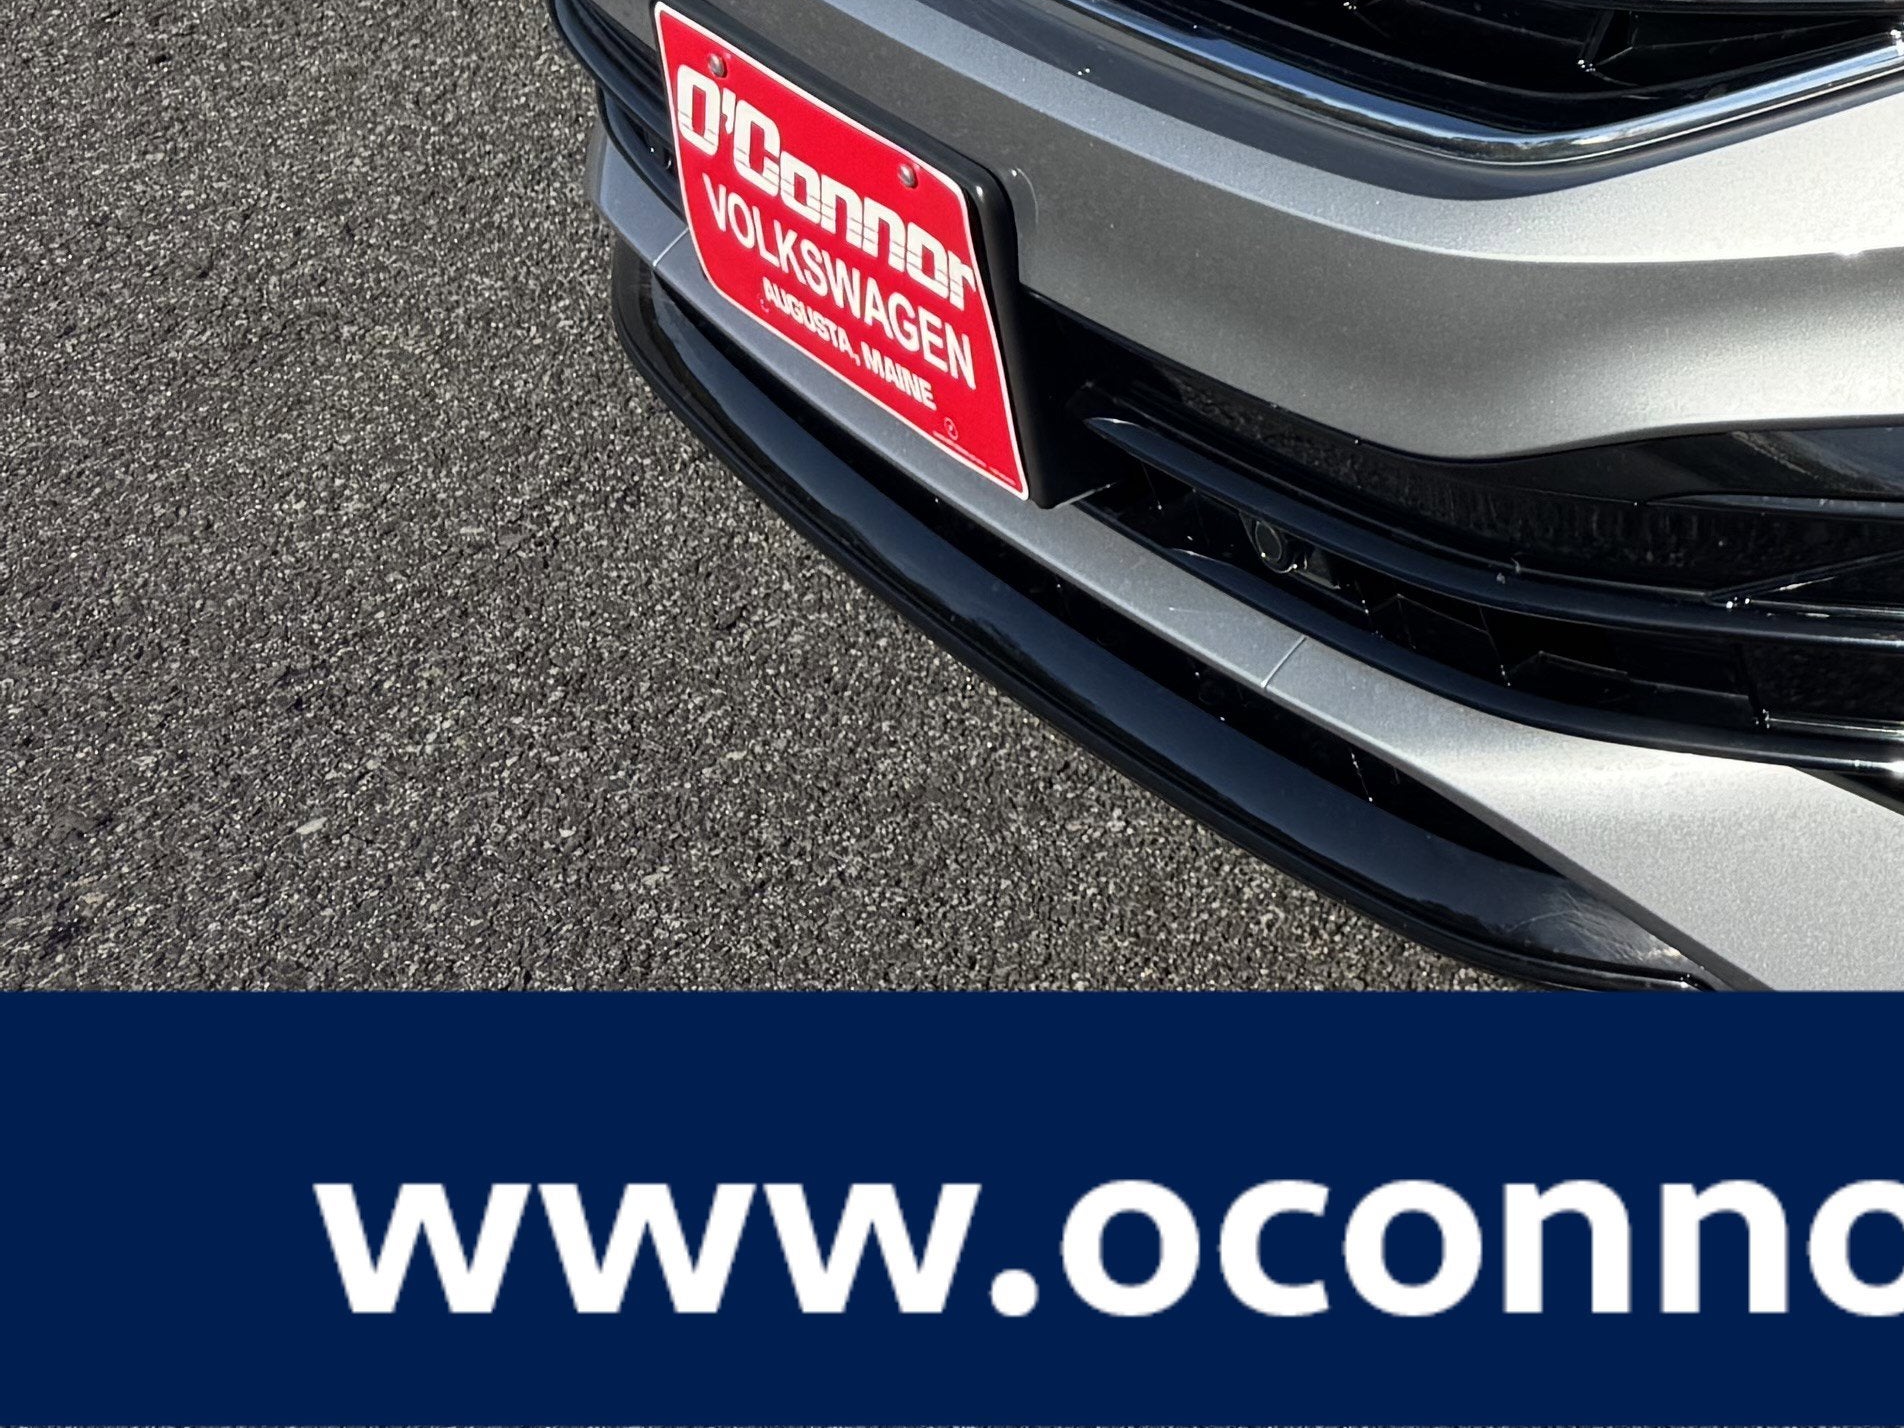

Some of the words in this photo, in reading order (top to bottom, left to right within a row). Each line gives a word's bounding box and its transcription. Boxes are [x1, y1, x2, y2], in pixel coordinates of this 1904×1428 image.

[676, 63, 978, 312] O'Connor
[702, 171, 978, 391] VOLKSWAGEN
[762, 275, 862, 369] AUGUSTA,
[860, 341, 939, 412] MAINE
